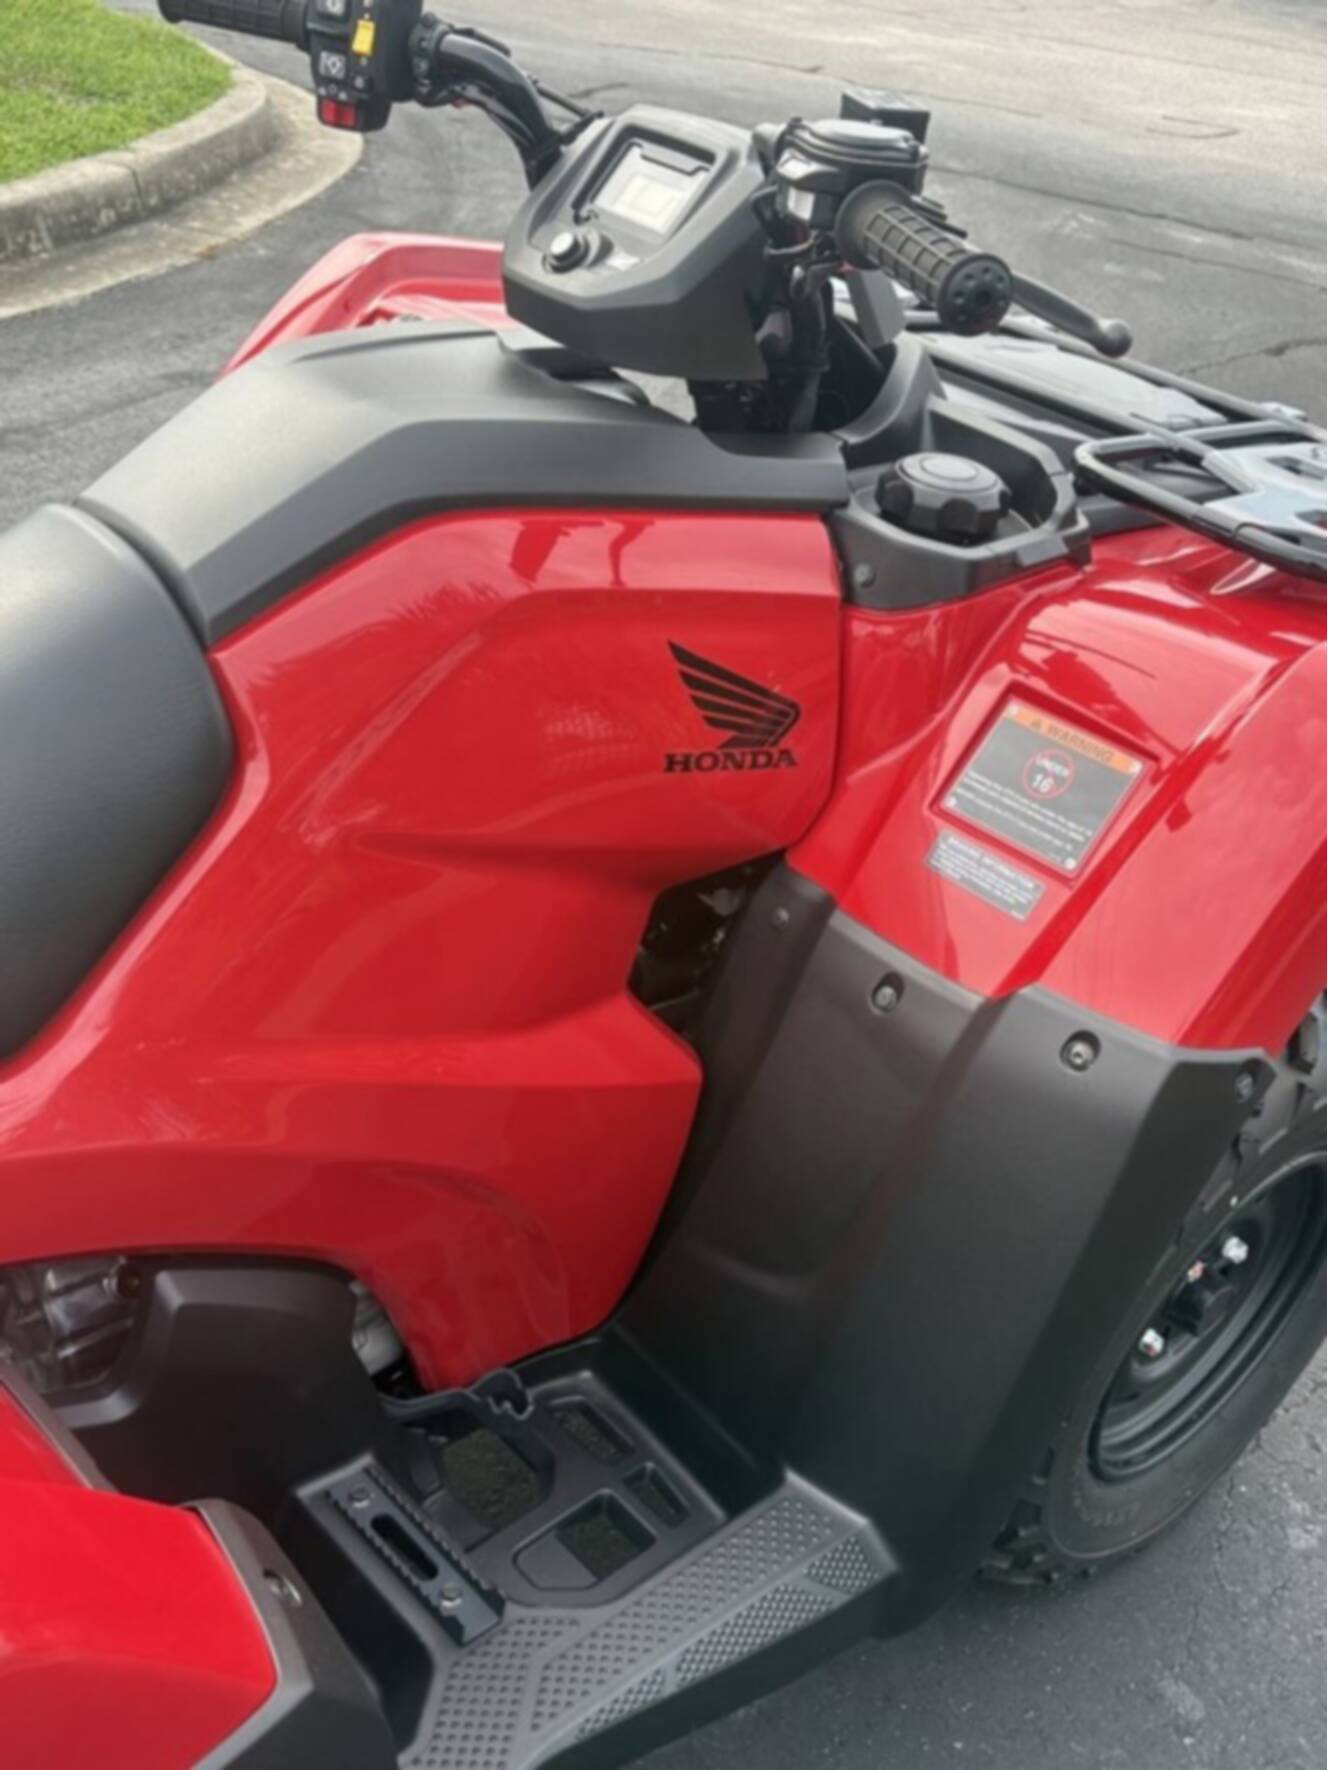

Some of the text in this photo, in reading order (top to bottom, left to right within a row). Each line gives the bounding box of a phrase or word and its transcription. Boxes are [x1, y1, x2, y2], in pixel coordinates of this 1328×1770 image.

[1046, 722, 1116, 764] WARNING
[663, 749, 797, 773] HONDA
[1032, 773, 1055, 793] 16
